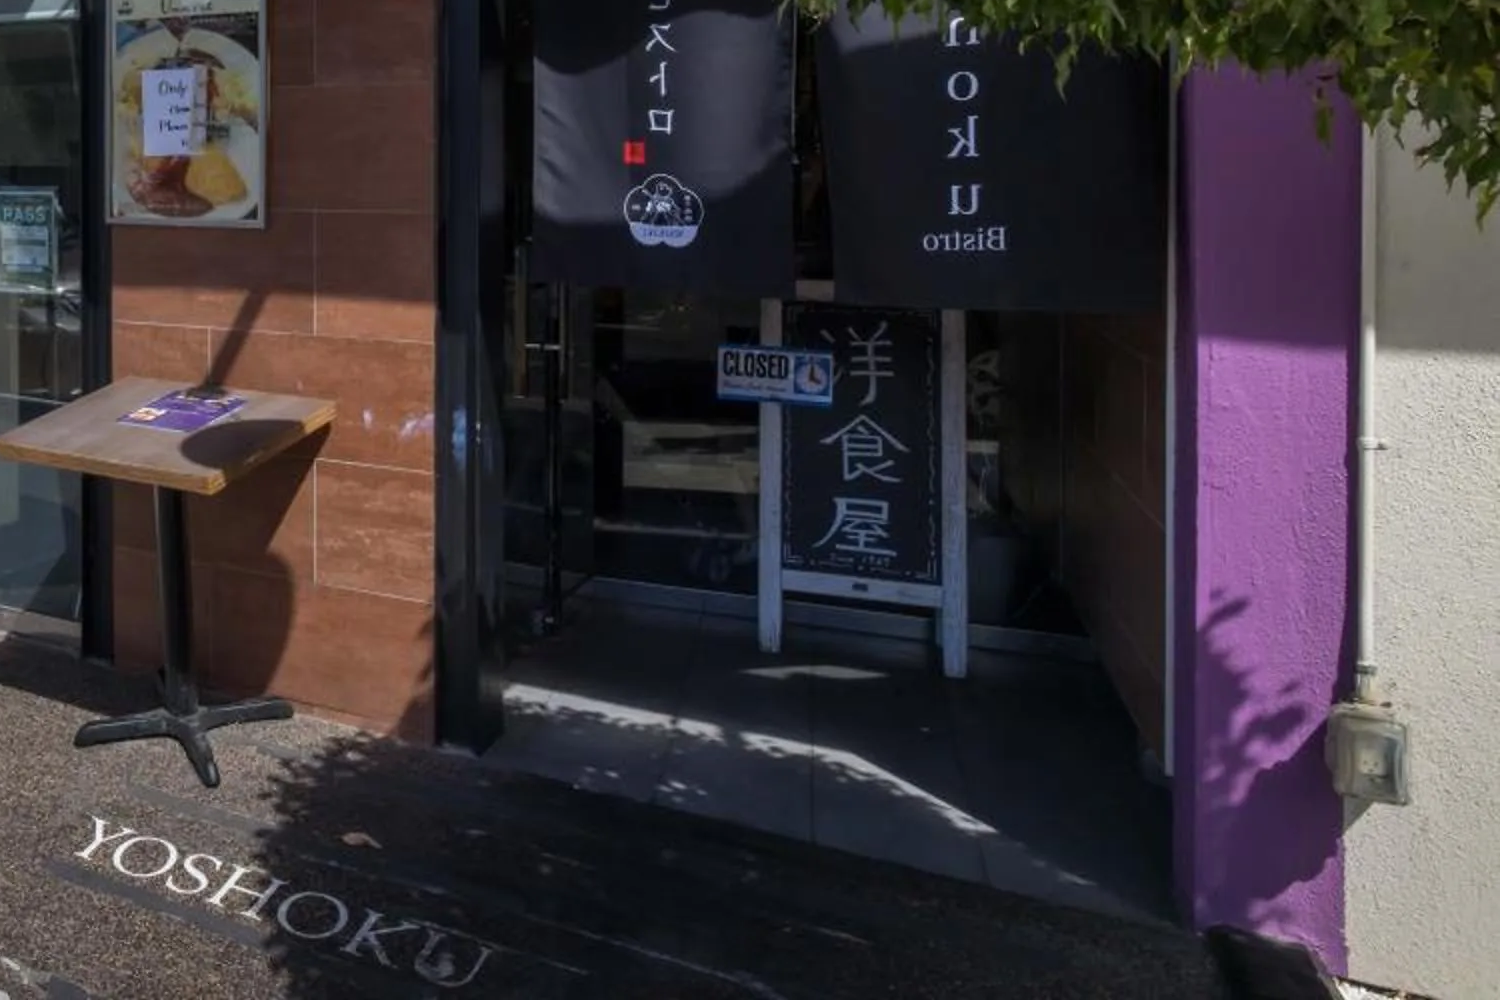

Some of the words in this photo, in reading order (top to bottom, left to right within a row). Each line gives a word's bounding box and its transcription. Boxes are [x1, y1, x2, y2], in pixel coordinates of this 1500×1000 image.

[2, 205, 46, 225] PASS
[723, 349, 790, 380] CLOSED
[812, 320, 911, 557] 洋食屋
[74, 811, 493, 988] YOSHOKU
